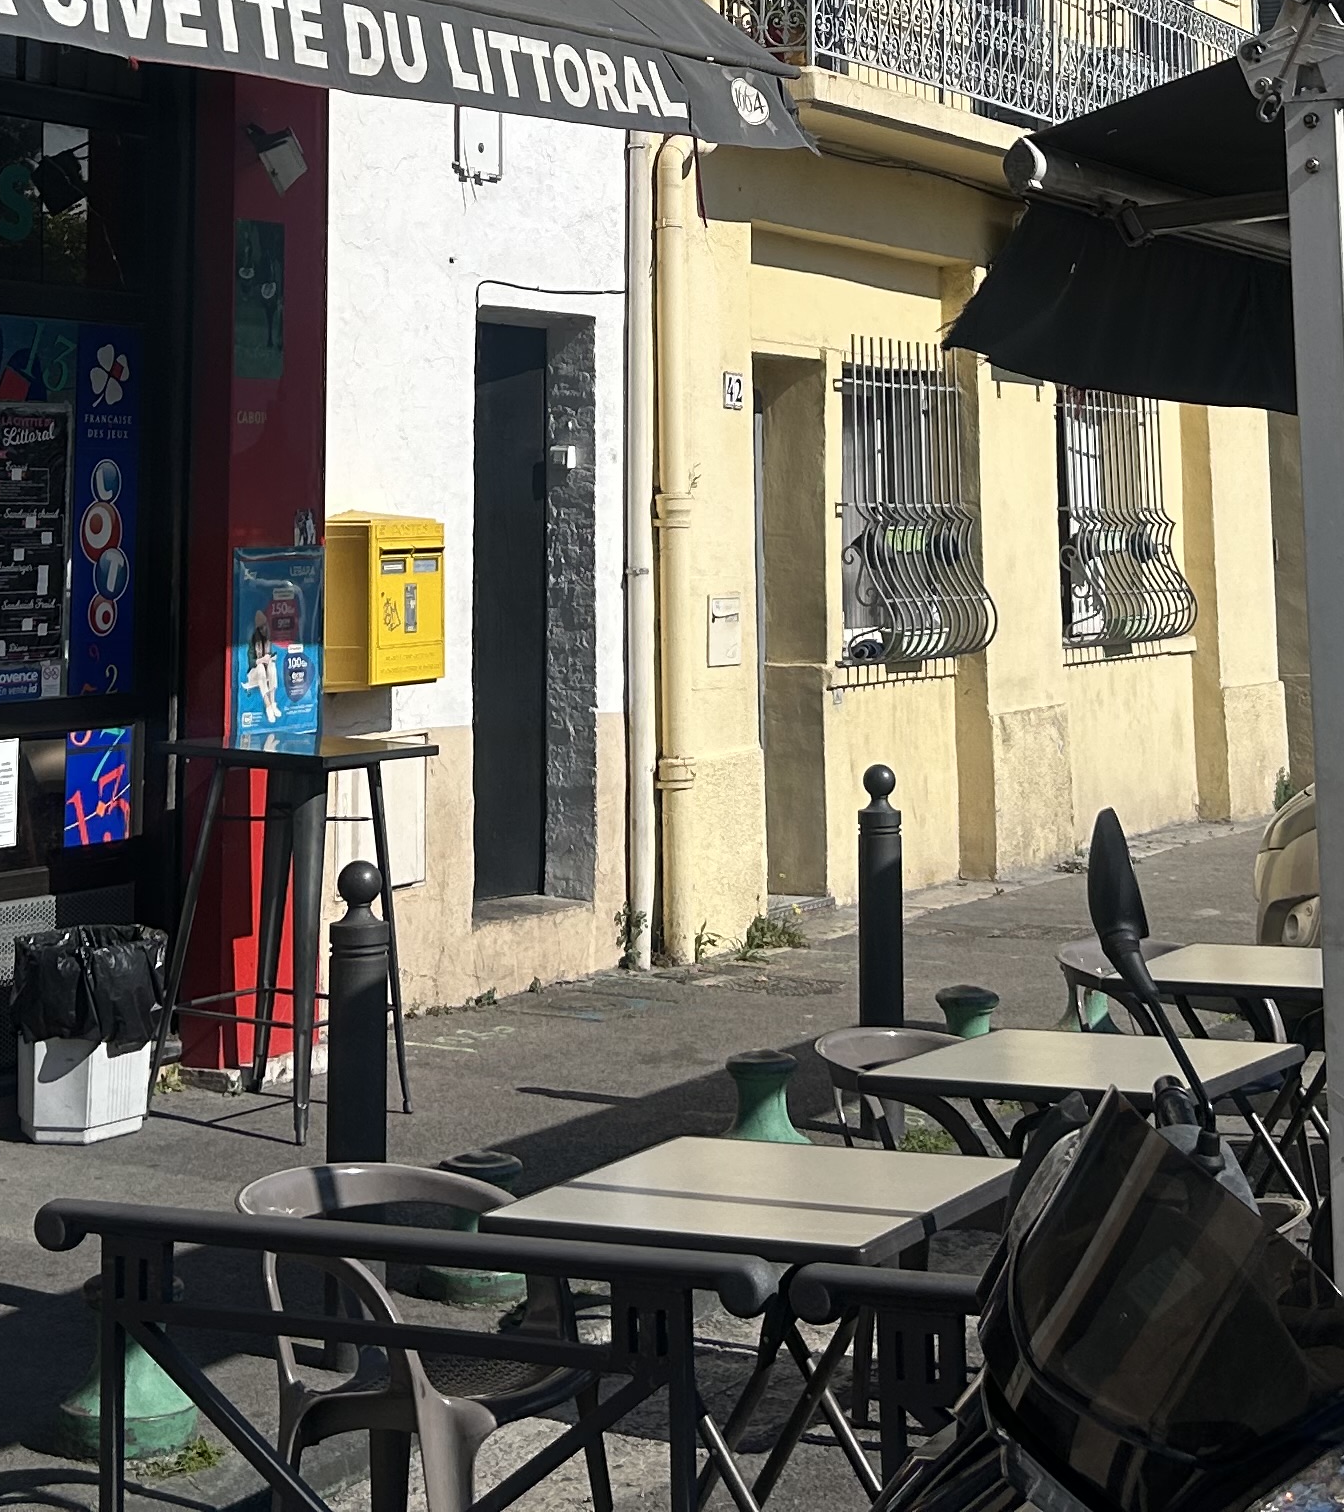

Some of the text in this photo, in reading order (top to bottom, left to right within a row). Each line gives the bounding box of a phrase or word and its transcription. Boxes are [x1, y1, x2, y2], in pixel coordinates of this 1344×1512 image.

[342, 1, 428, 84] DU
[440, 21, 688, 119] LITTORAL
[726, 377, 743, 404] 42
[84, 413, 133, 426] FRANÇAISE
[2, 421, 56, 447] Littoral
[87, 428, 129, 440] DES JEUX
